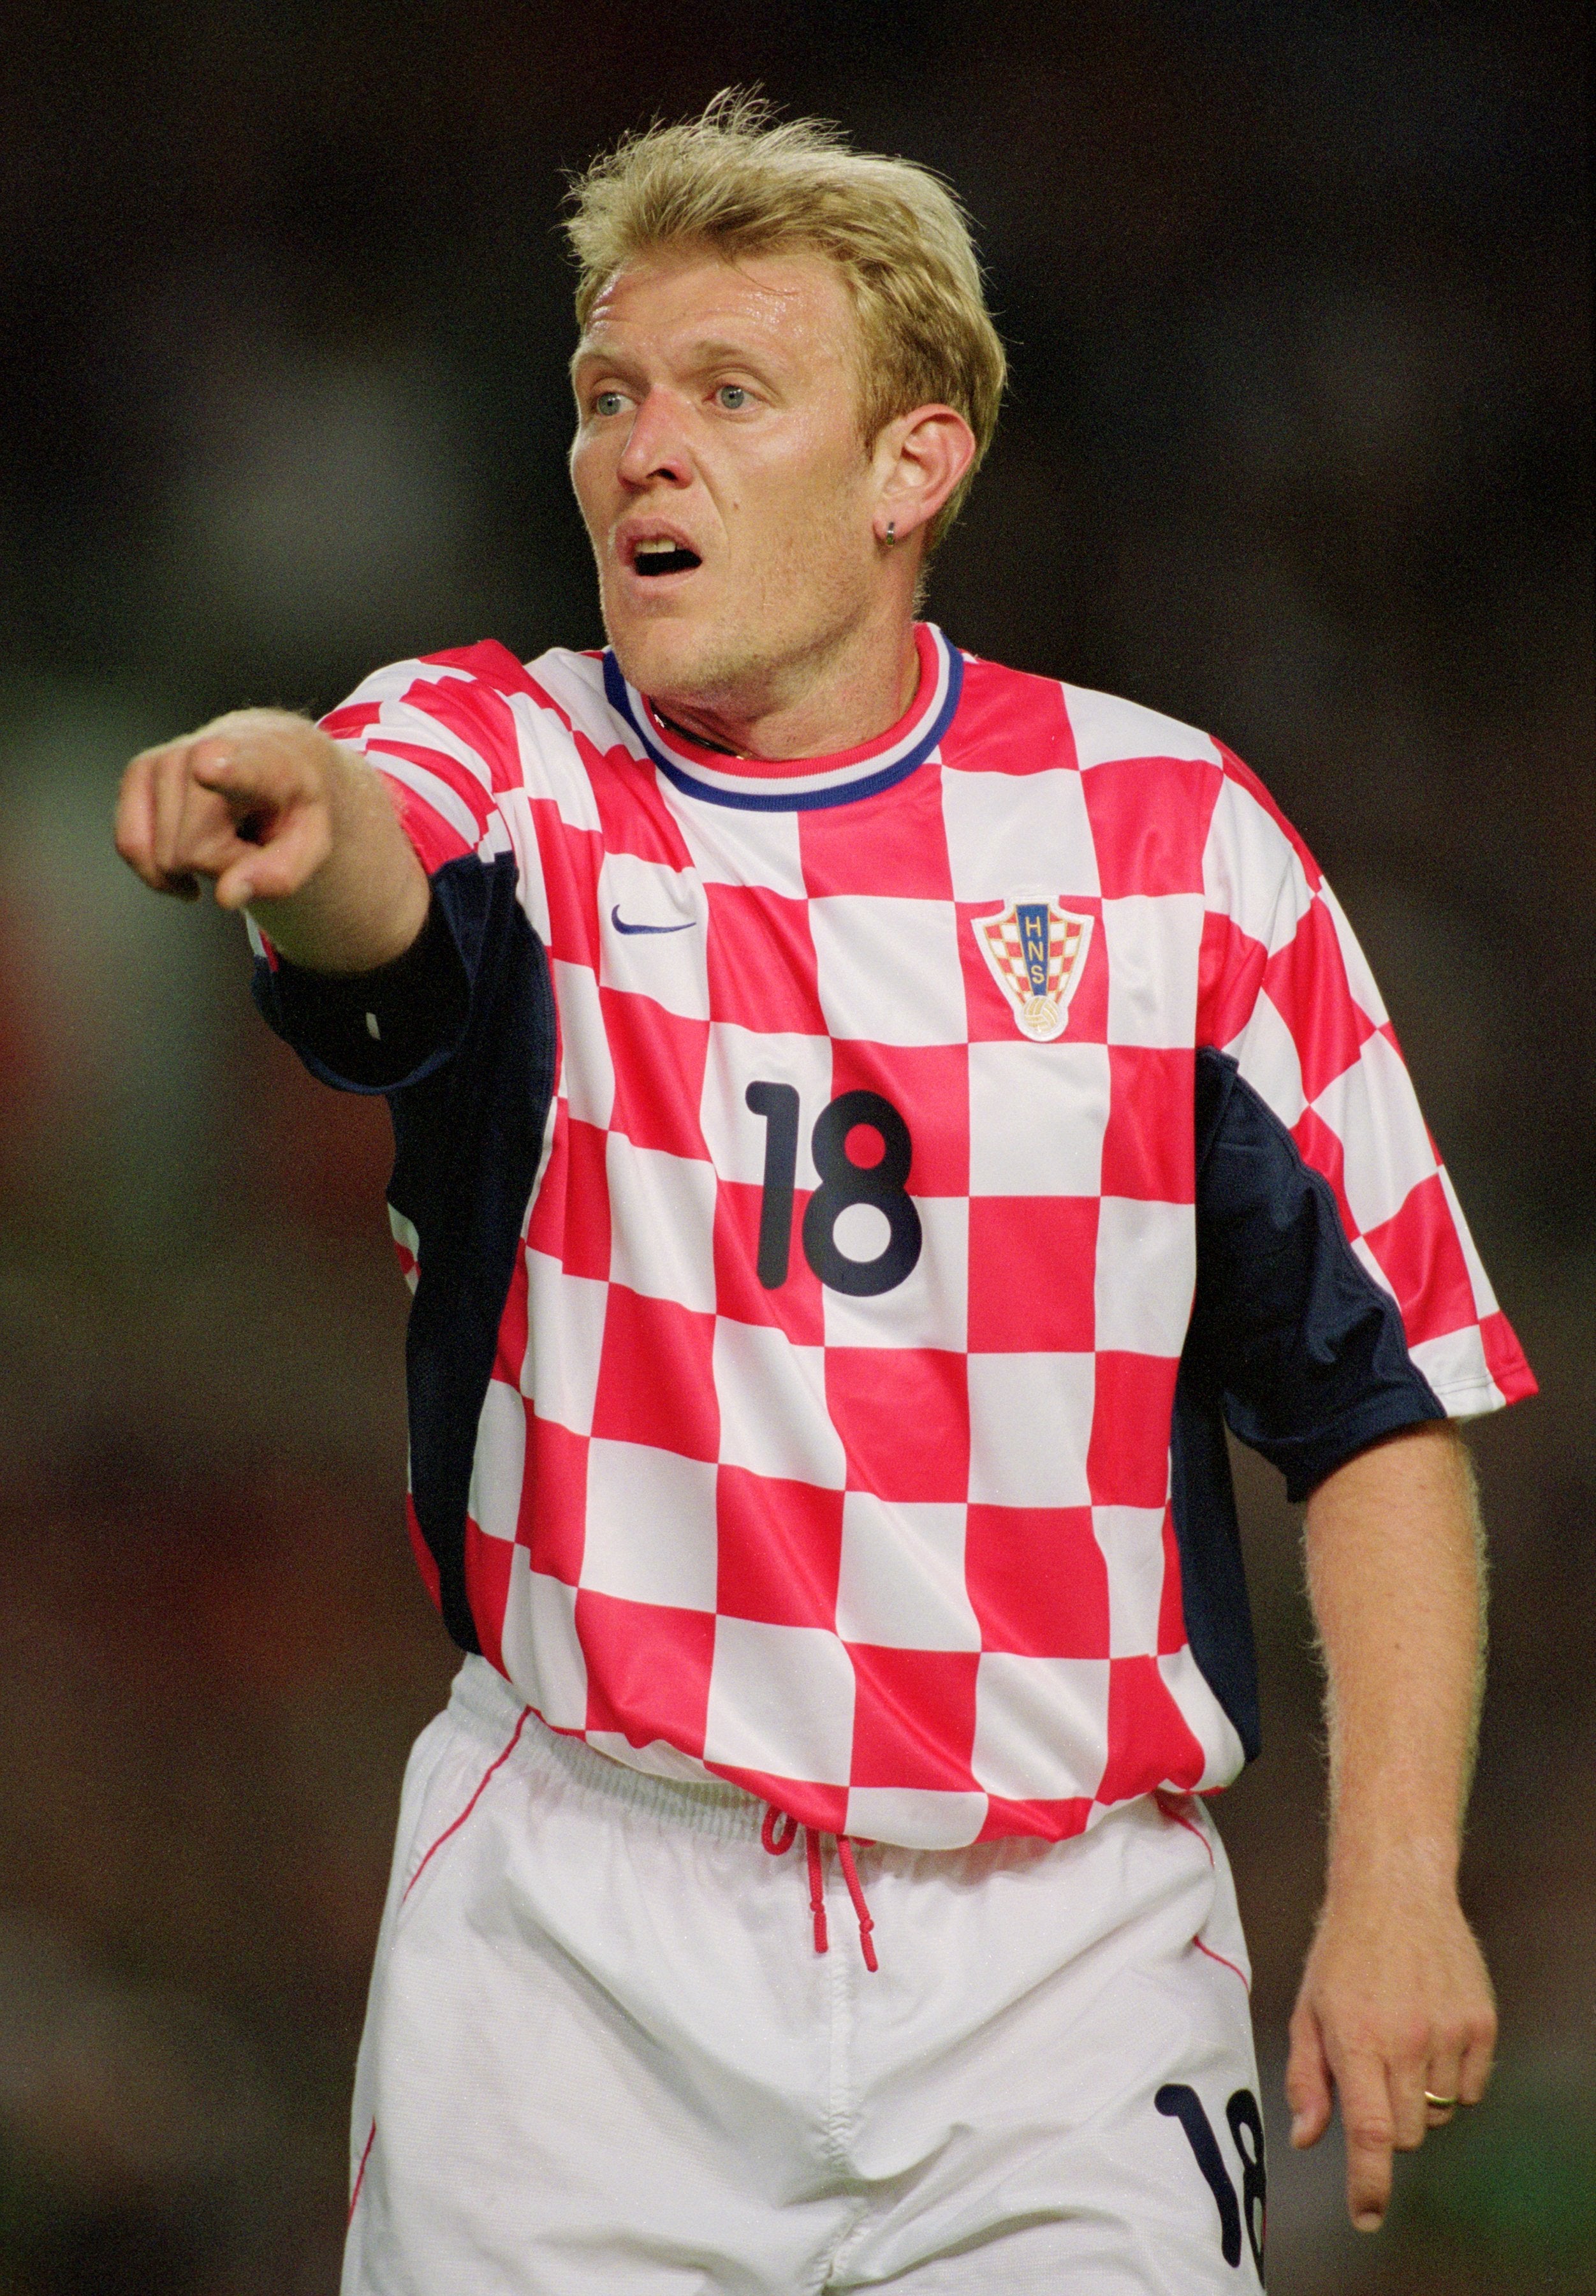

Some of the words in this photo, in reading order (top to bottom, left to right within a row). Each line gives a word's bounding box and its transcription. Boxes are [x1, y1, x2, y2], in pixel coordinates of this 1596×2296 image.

[1025, 916, 1045, 983] HNS
[745, 1080, 923, 1297] 18
[1153, 2083, 1266, 2290] 18
